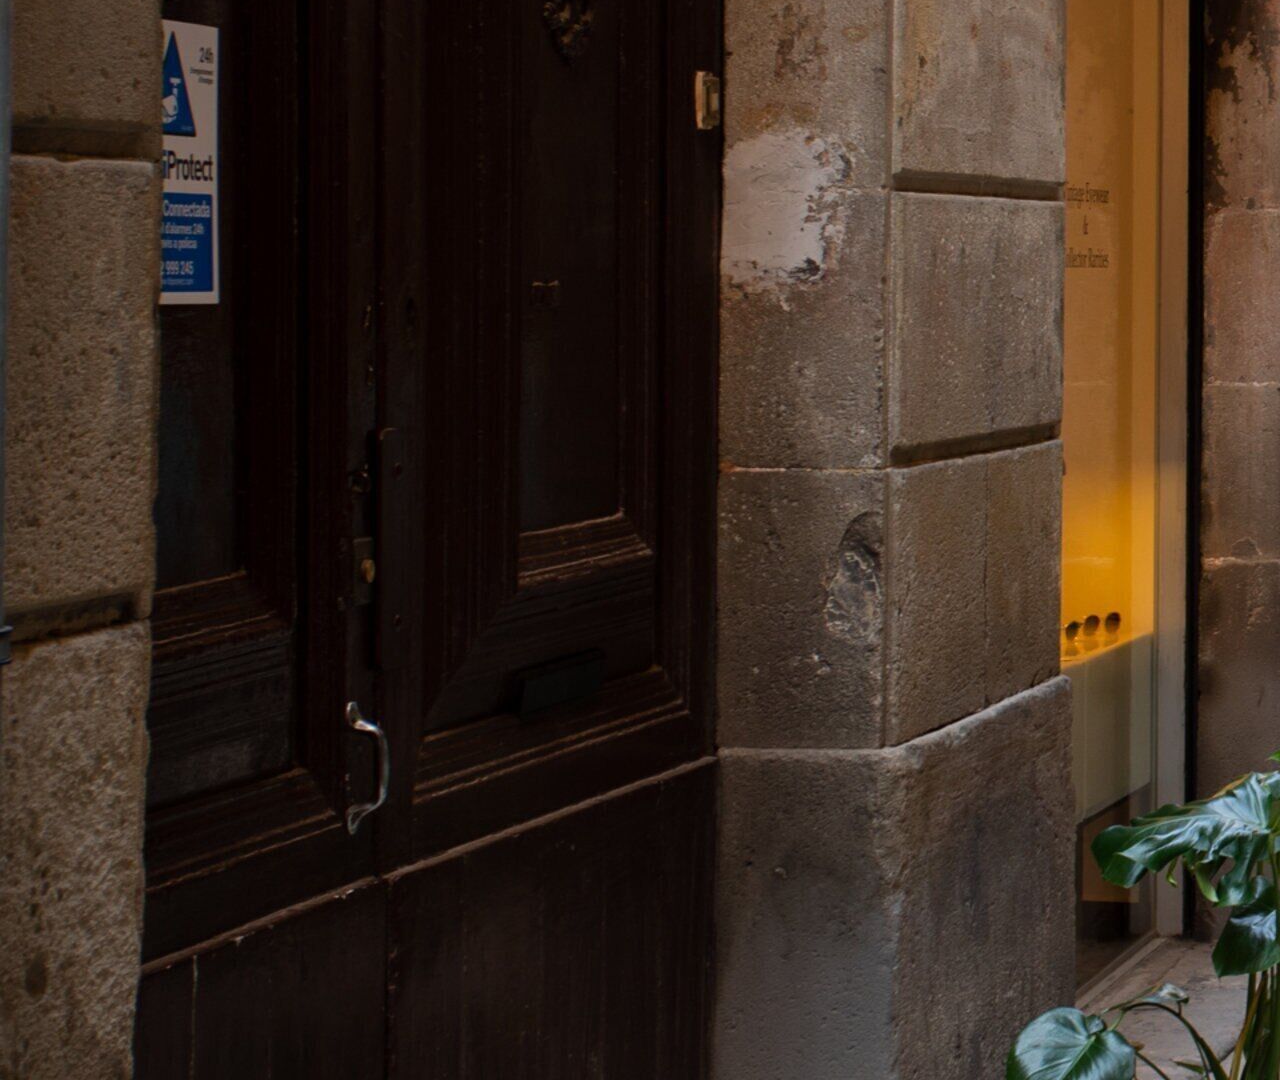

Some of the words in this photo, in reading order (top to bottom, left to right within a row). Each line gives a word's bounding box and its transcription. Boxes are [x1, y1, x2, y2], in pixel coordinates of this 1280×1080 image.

[200, 47, 214, 64] 24h
[161, 149, 213, 181] iProtect
[162, 200, 211, 217] Connectada
